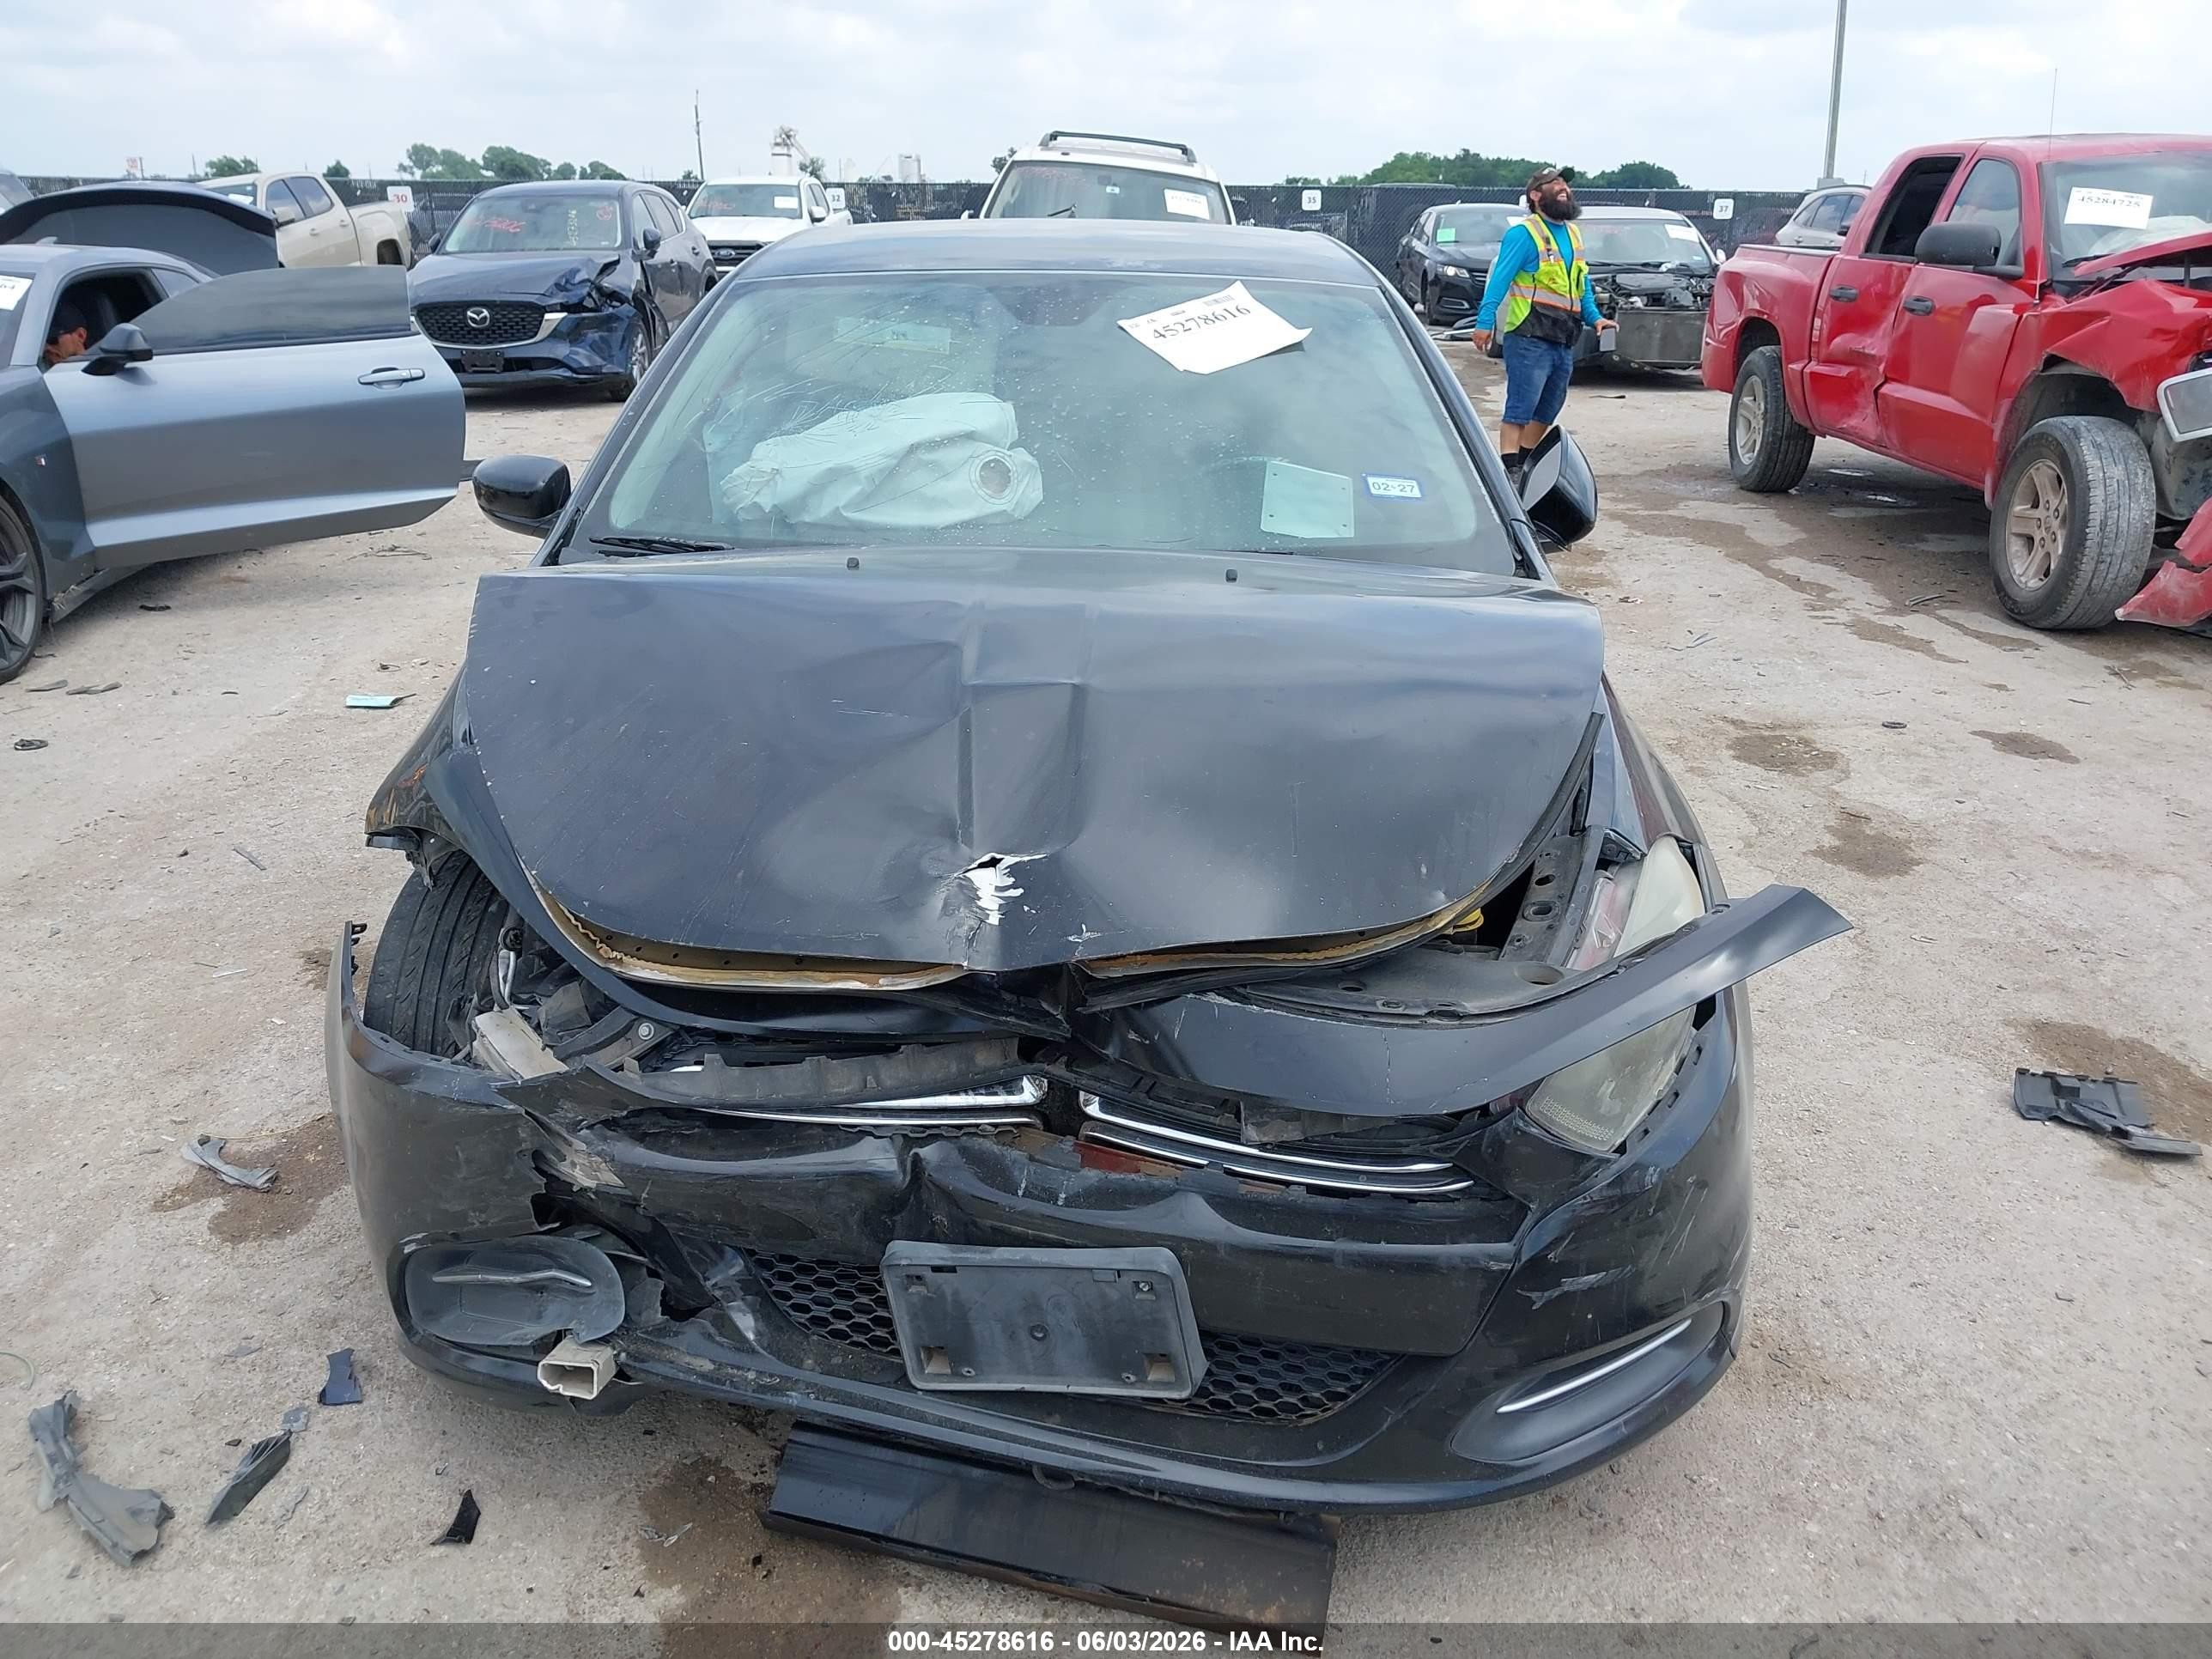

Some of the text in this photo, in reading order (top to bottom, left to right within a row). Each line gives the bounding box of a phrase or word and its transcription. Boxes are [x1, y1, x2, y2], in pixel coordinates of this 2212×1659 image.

[393, 193, 408, 204] 30
[831, 194, 841, 203] 32
[1307, 196, 1317, 204] 35
[2077, 195, 2141, 208] 45284725
[1152, 304, 1251, 340] 45278616
